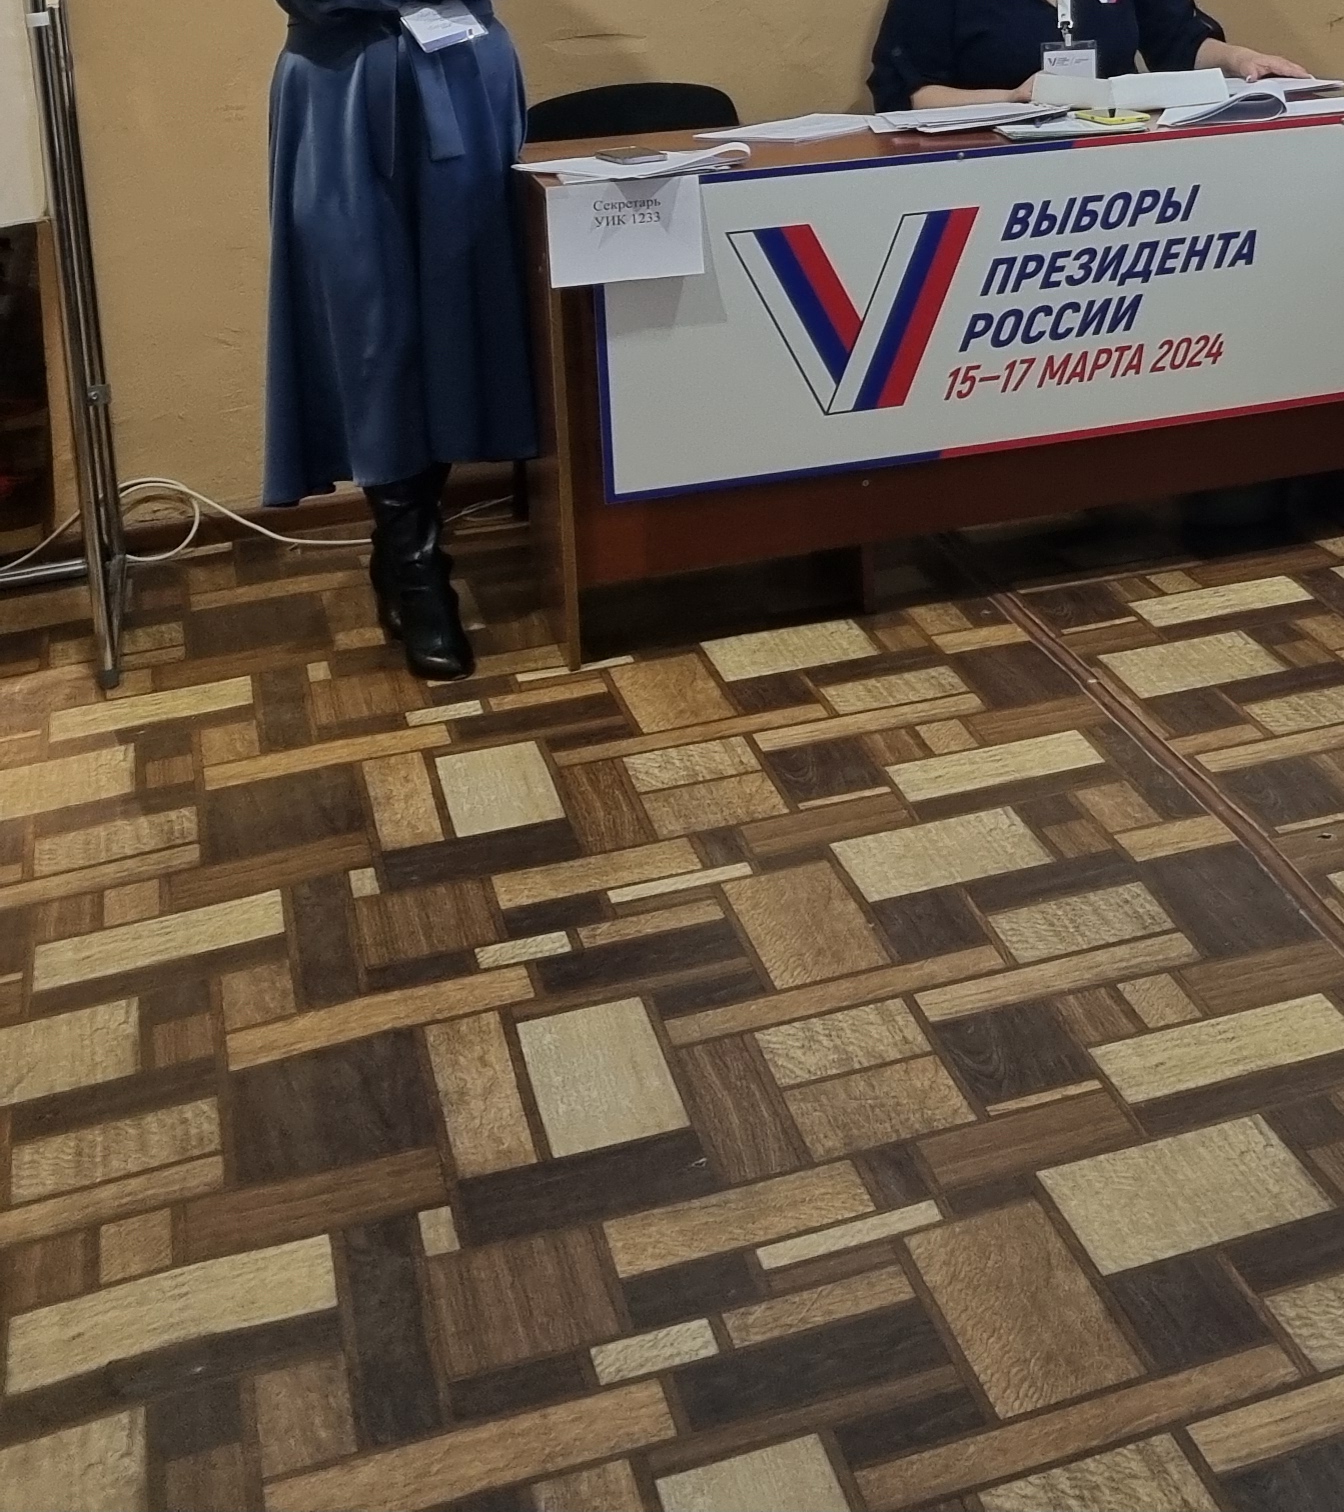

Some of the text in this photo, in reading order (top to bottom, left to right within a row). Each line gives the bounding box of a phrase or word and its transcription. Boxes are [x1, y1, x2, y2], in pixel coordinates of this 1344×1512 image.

[593, 198, 661, 212] Секретарь
[594, 211, 660, 228] УИК 1233
[1001, 184, 1201, 241] ВЫБОРЫ
[979, 229, 1257, 297] ПРЕЗИДЕНТА
[958, 293, 1143, 353] РОССИИ
[1036, 344, 1144, 388] МАРТА
[1149, 333, 1224, 373] 2024
